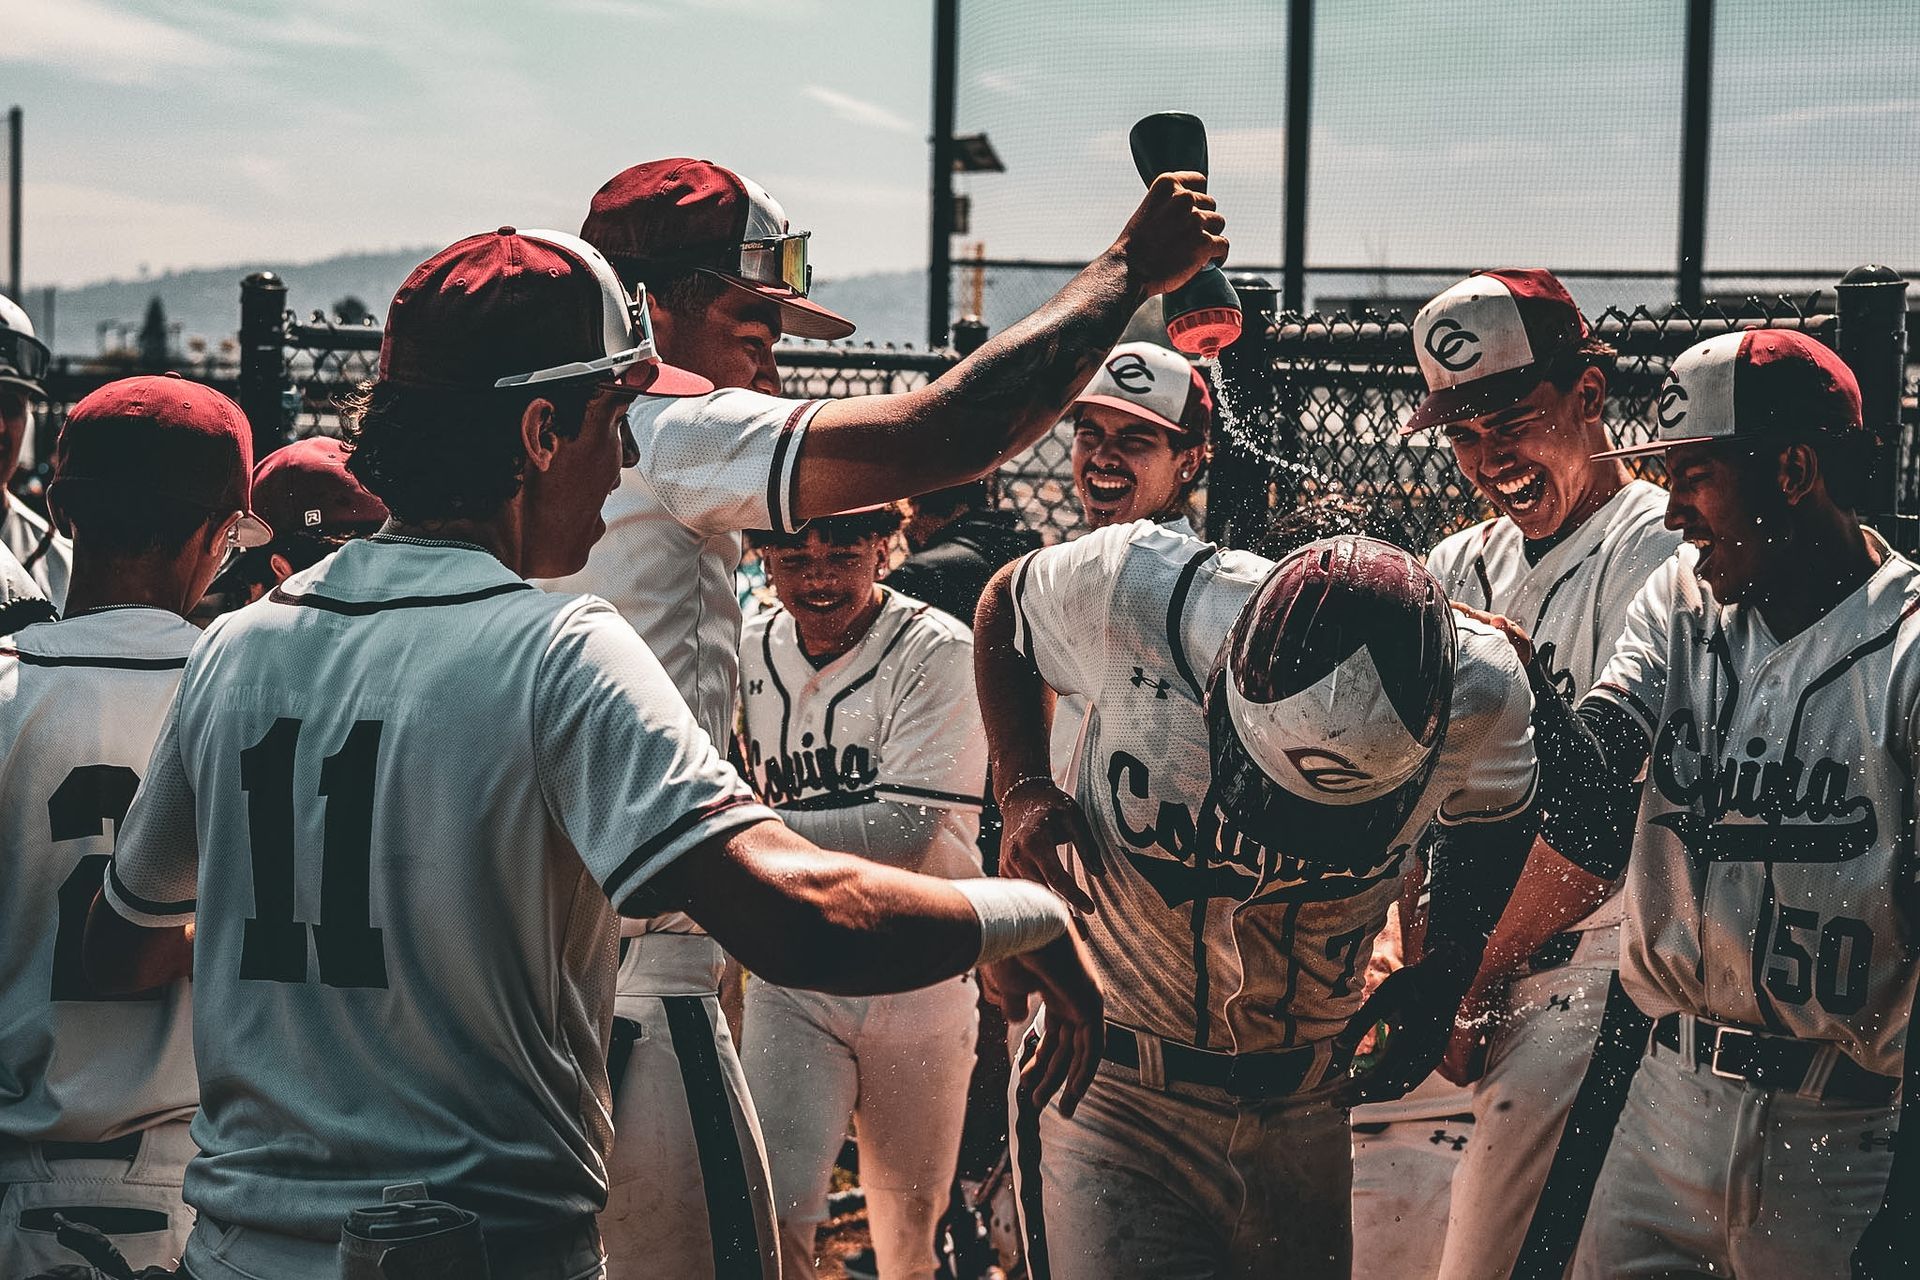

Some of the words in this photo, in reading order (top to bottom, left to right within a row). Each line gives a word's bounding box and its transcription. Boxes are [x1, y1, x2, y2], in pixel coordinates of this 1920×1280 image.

[306, 511, 320, 524] R
[1652, 708, 1877, 830] Cvina
[239, 717, 389, 989] 11
[1325, 925, 1366, 998] 7
[1766, 903, 1873, 1015] 50
